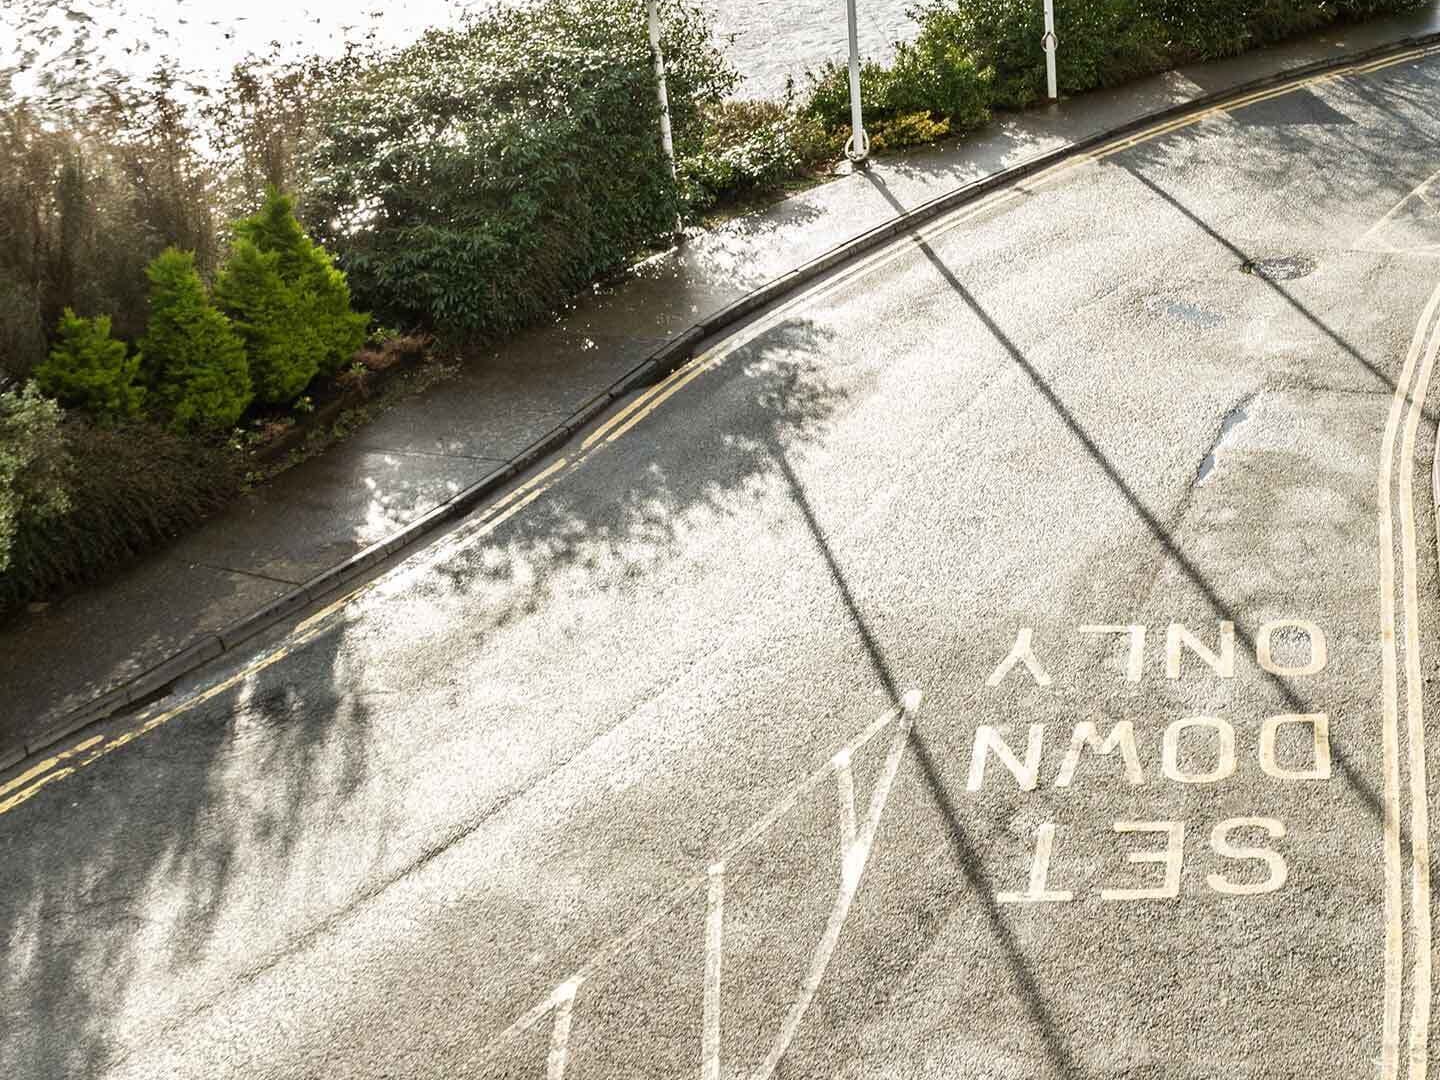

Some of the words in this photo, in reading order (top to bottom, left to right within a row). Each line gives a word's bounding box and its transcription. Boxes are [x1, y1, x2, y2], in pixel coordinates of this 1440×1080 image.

[986, 620, 1328, 687] ONLY
[966, 713, 1331, 791] DOWN
[997, 817, 1288, 903] SET
